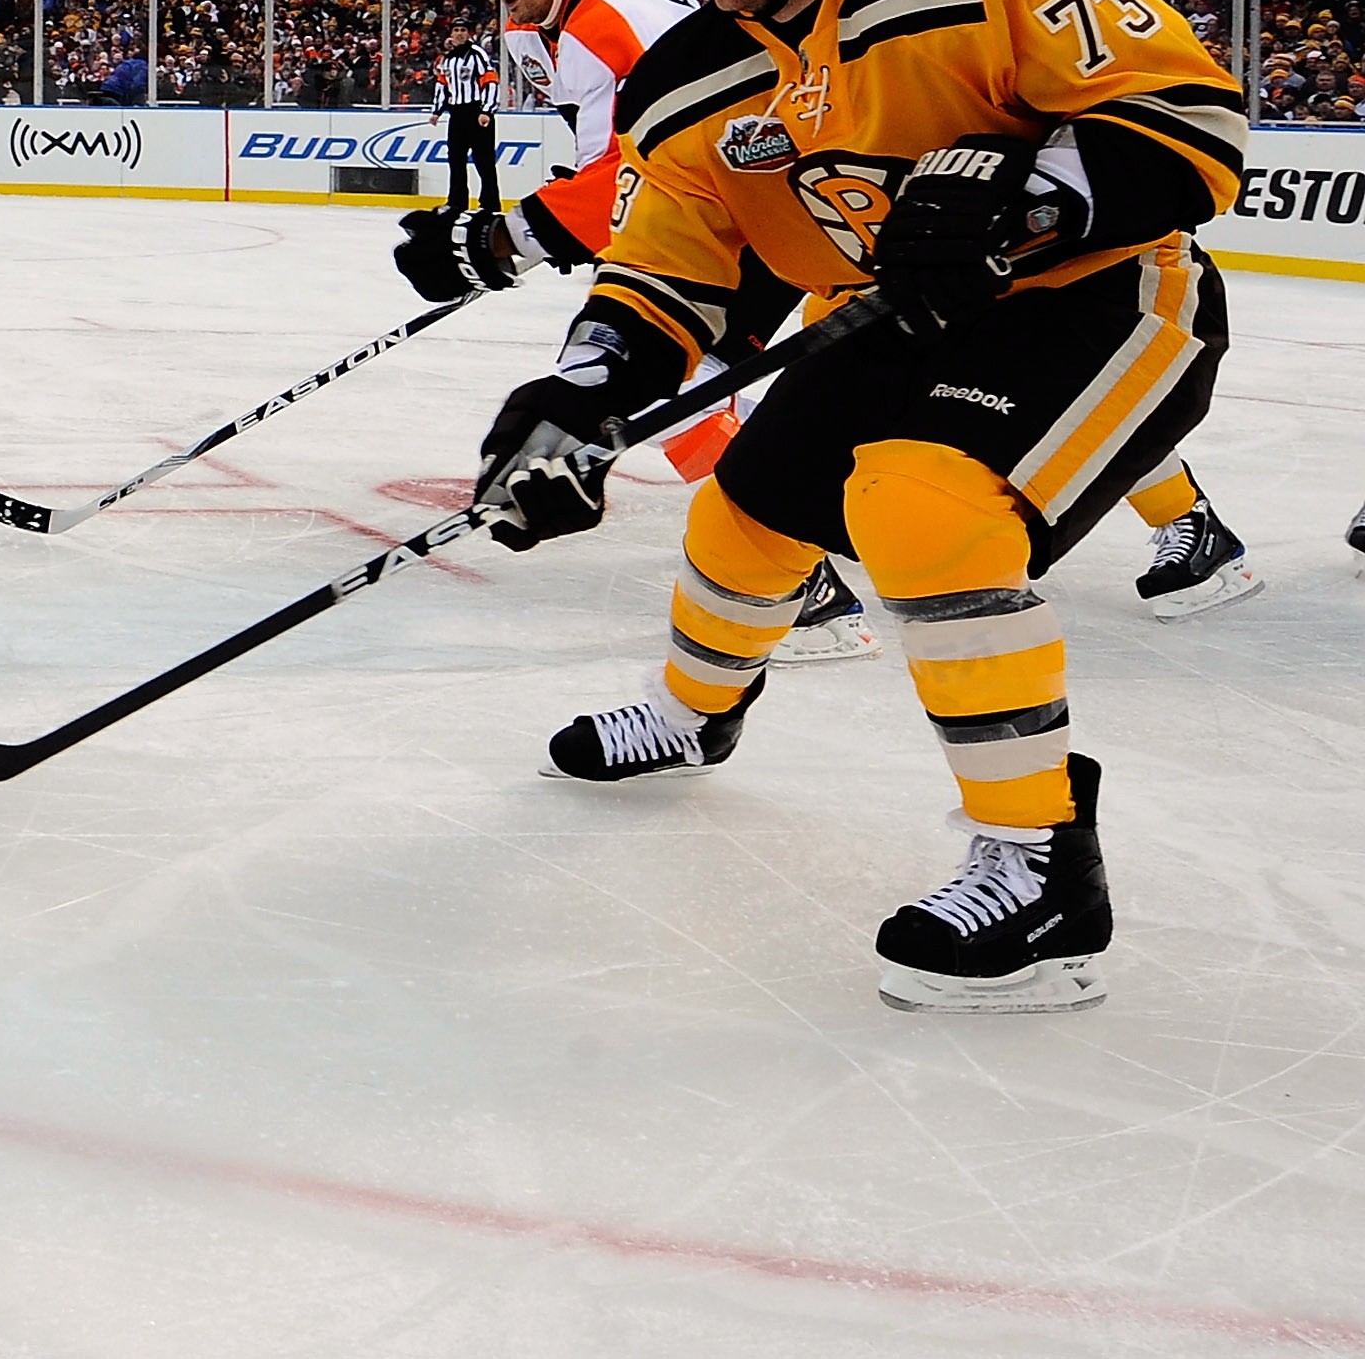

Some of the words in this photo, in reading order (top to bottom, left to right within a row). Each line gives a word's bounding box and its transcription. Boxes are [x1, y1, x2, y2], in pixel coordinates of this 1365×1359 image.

[239, 132, 358, 161] BUD
[233, 323, 409, 435] EASTON
[929, 383, 1017, 416] Reebok
